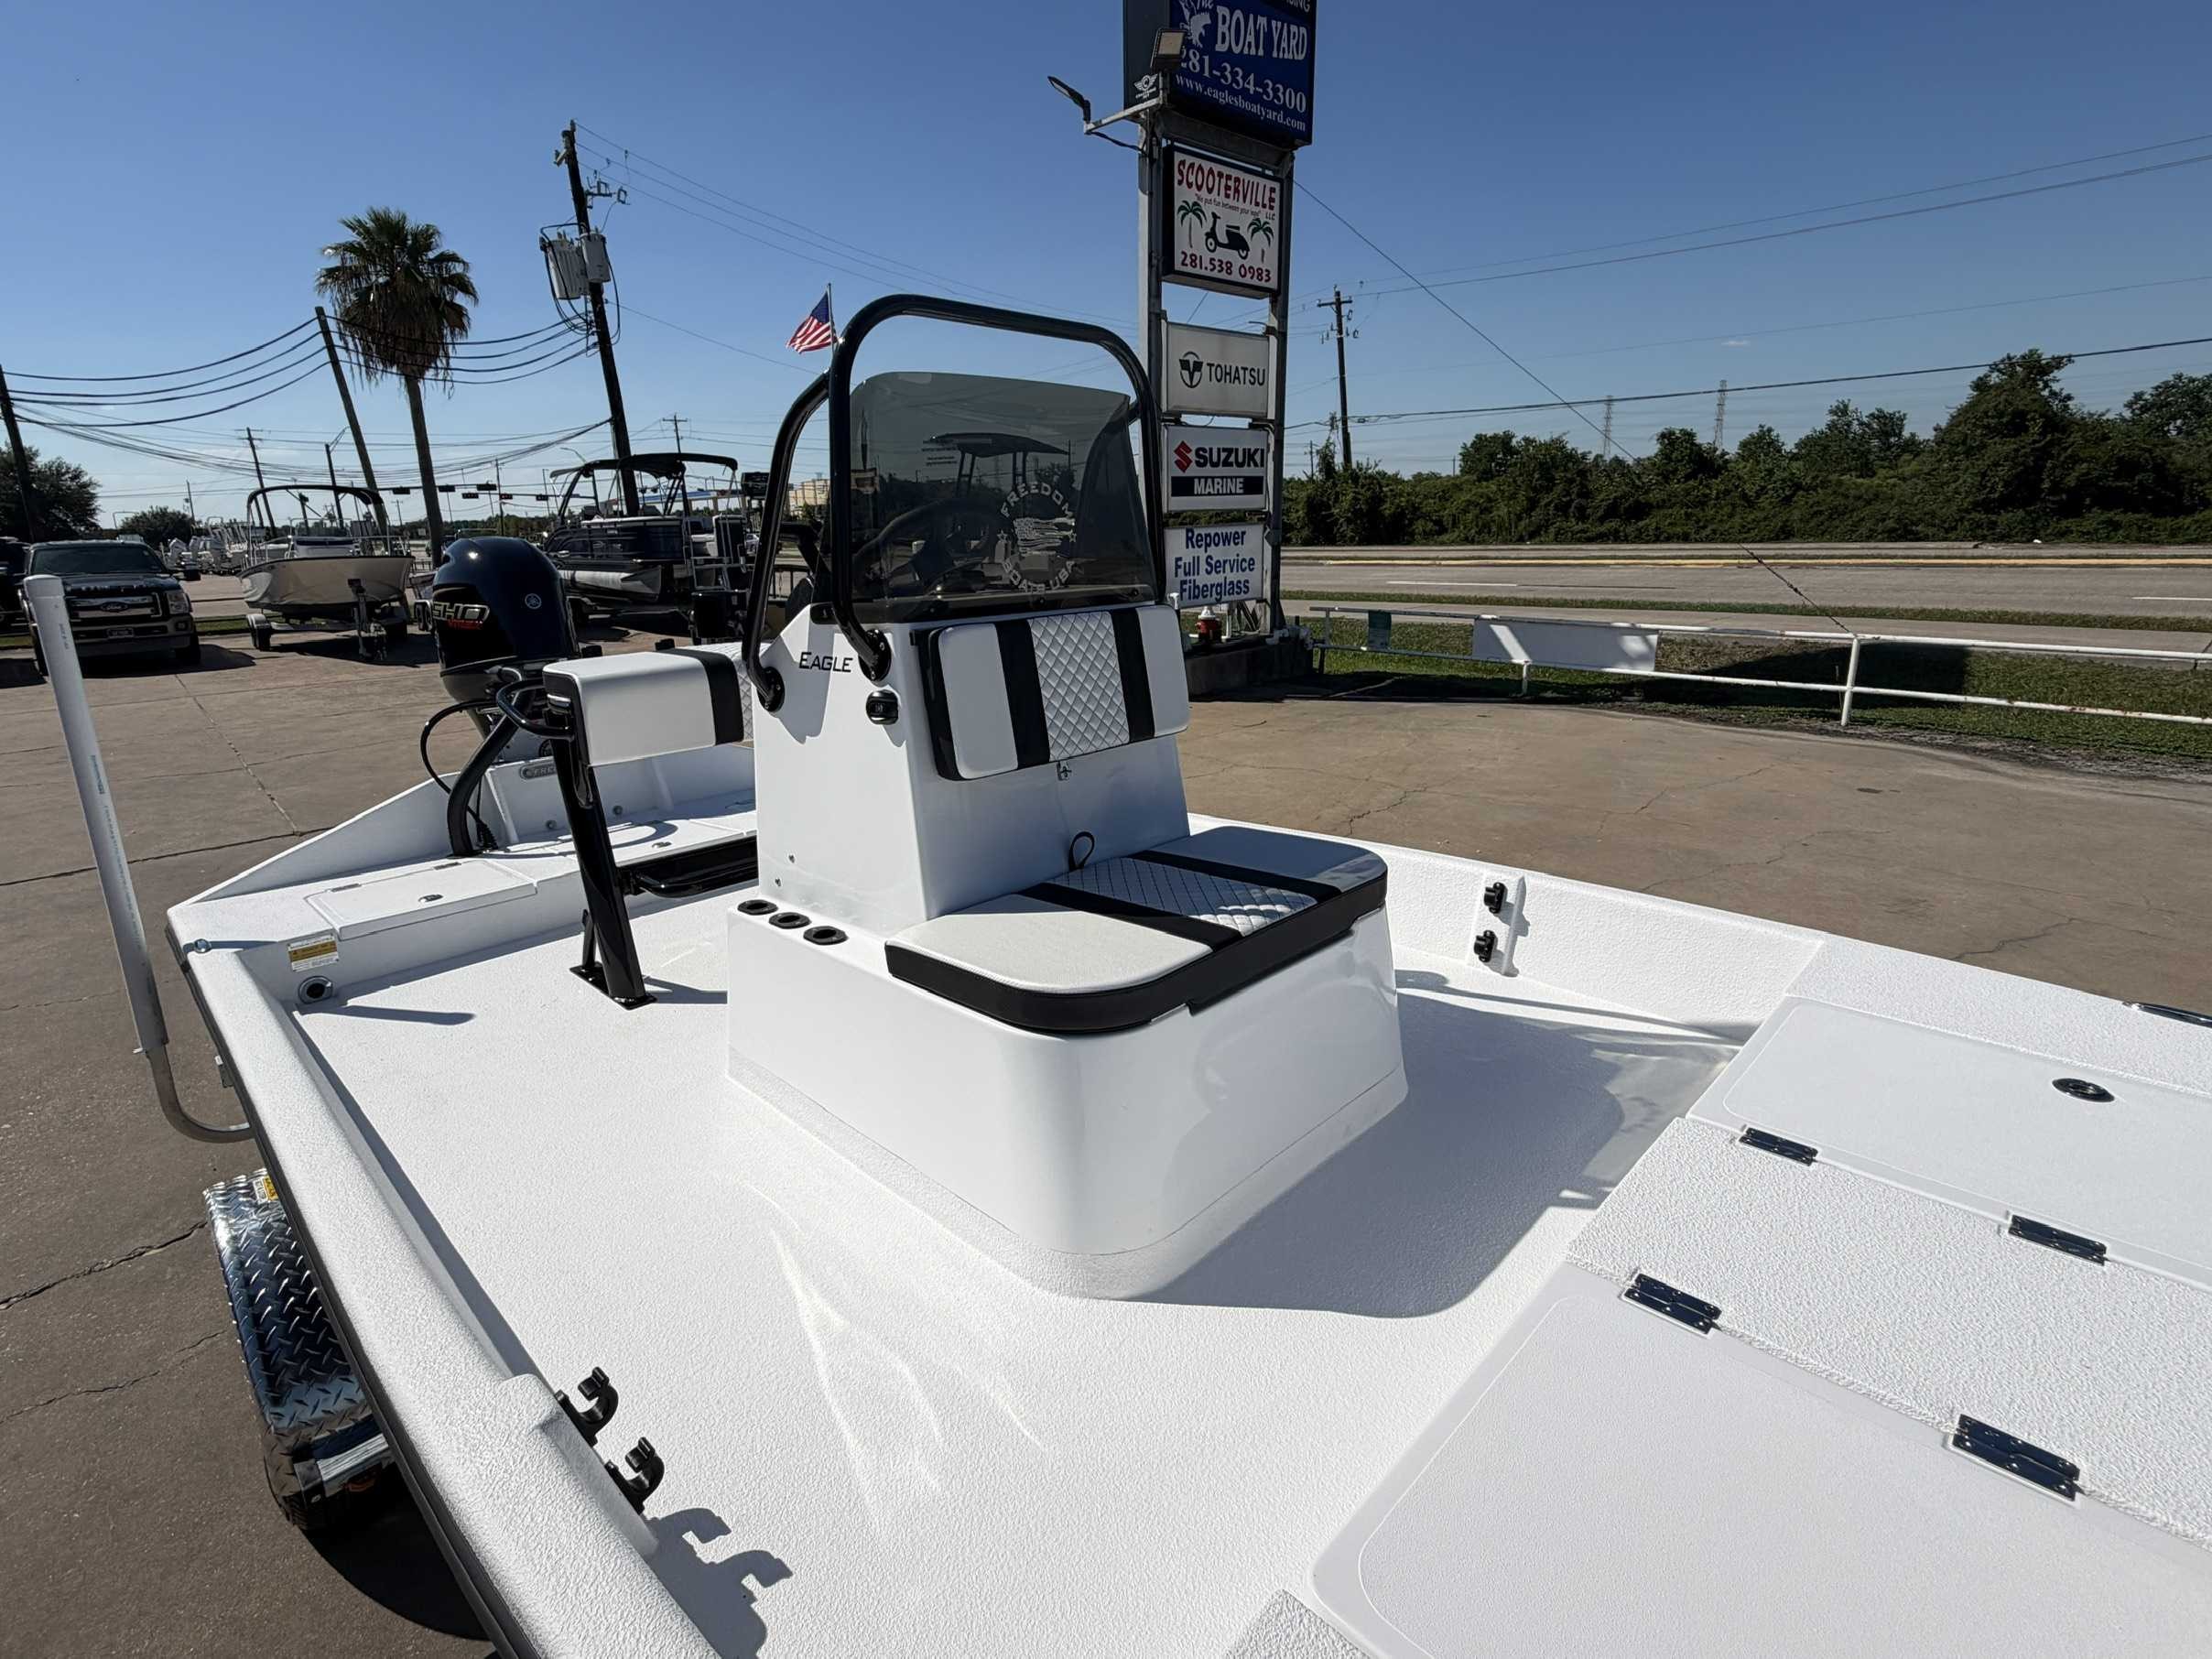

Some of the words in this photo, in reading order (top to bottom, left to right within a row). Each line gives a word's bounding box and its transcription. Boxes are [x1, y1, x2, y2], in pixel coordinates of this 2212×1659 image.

[1215, 5, 1268, 57] BOAT
[1272, 19, 1307, 60] YARD
[1176, 74, 1307, 132] www.eaglesboatyard.com
[1176, 159, 1276, 211] SCOOTERVILLE
[1265, 211, 1275, 221] LLC
[1181, 251, 1233, 276] 281.538
[1238, 264, 1271, 283] 0983
[1207, 363, 1265, 386] TOHATSU
[1195, 447, 1264, 468] SUZUKI
[1194, 477, 1244, 495] MARINE
[1001, 481, 1073, 518] FREEDOM
[1186, 527, 1246, 553] Repower
[1175, 556, 1200, 578] Full
[1205, 554, 1255, 576] Service
[1179, 577, 1250, 602] Fiberglass
[798, 652, 853, 673] EAGLE
